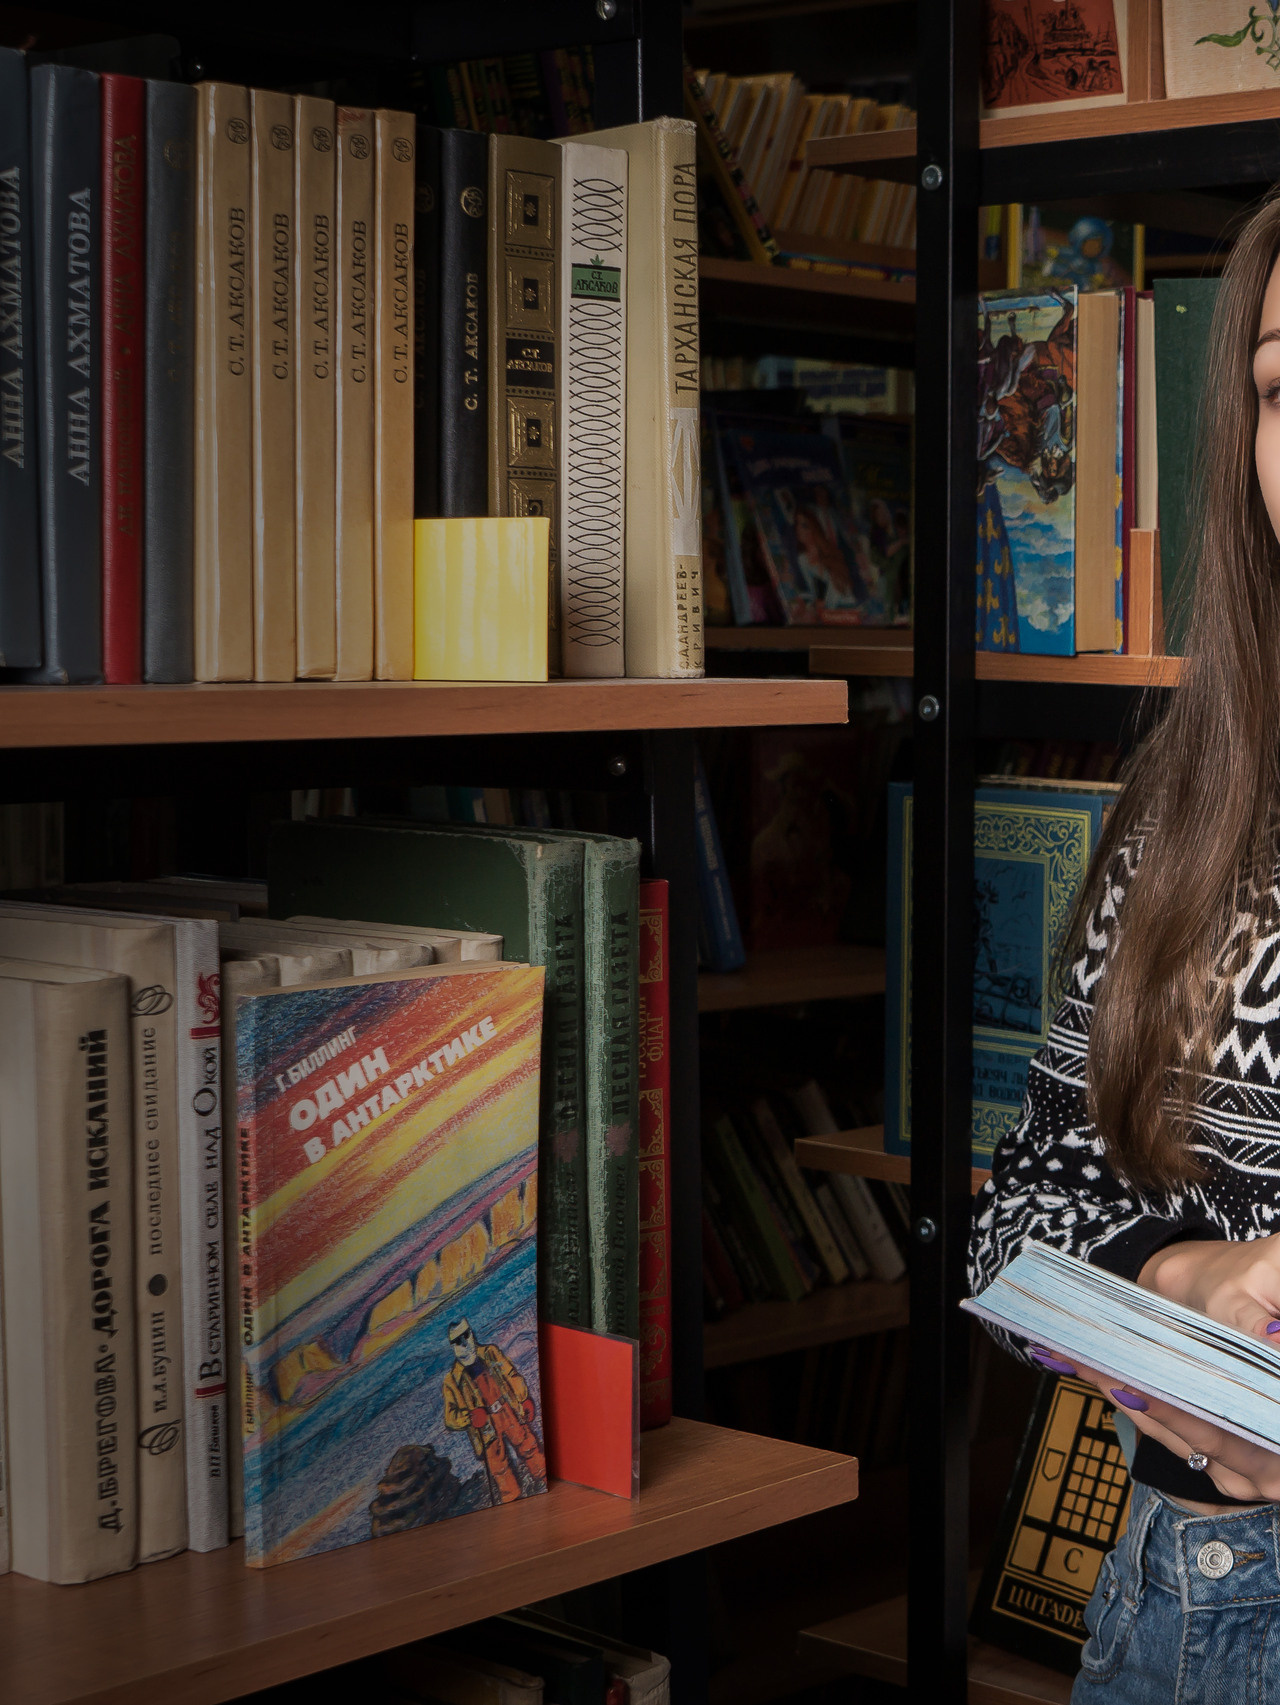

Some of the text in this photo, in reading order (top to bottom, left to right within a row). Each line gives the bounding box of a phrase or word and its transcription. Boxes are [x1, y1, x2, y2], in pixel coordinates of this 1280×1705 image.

[112, 134, 137, 262] АХМАТОВА
[113, 271, 136, 337] АННА
[229, 207, 247, 331] АКСАКОВ
[272, 213, 290, 332] АКСАКОВ
[313, 214, 330, 333] АКСАКОВ
[351, 220, 367, 339] АКСАКОВ
[394, 223, 410, 339] АКСАКОВ
[464, 272, 479, 360] АКСАКОВ
[574, 279, 619, 294] АКСАКОВ
[673, 162, 698, 395] ТАРХАНСКАЯ ПОРА
[67, 187, 91, 486] АННА АХМАТОВА
[2, 367, 24, 468] АННА
[555, 913, 578, 1009] ГАЗЕТА
[611, 910, 631, 1116] ЛЕСНАЯ ГАЗЕТА
[142, 1027, 161, 1131] свидание
[288, 1046, 392, 1131] ОДИН
[303, 1015, 499, 1165] В АНТАРКТИКЕ
[645, 1015, 664, 1062] ФЛАГ
[79, 1029, 110, 1192] ИСКАНИЙ
[145, 1138, 163, 1256] последнее
[239, 1127, 251, 1257] АНТАРКТИКЕ
[88, 1201, 119, 1338] ДОРОГА
[242, 1286, 255, 1347] ОДИН
[199, 1357, 222, 1381] В
[1008, 1585, 1087, 1631] ЦИТАДЕ
